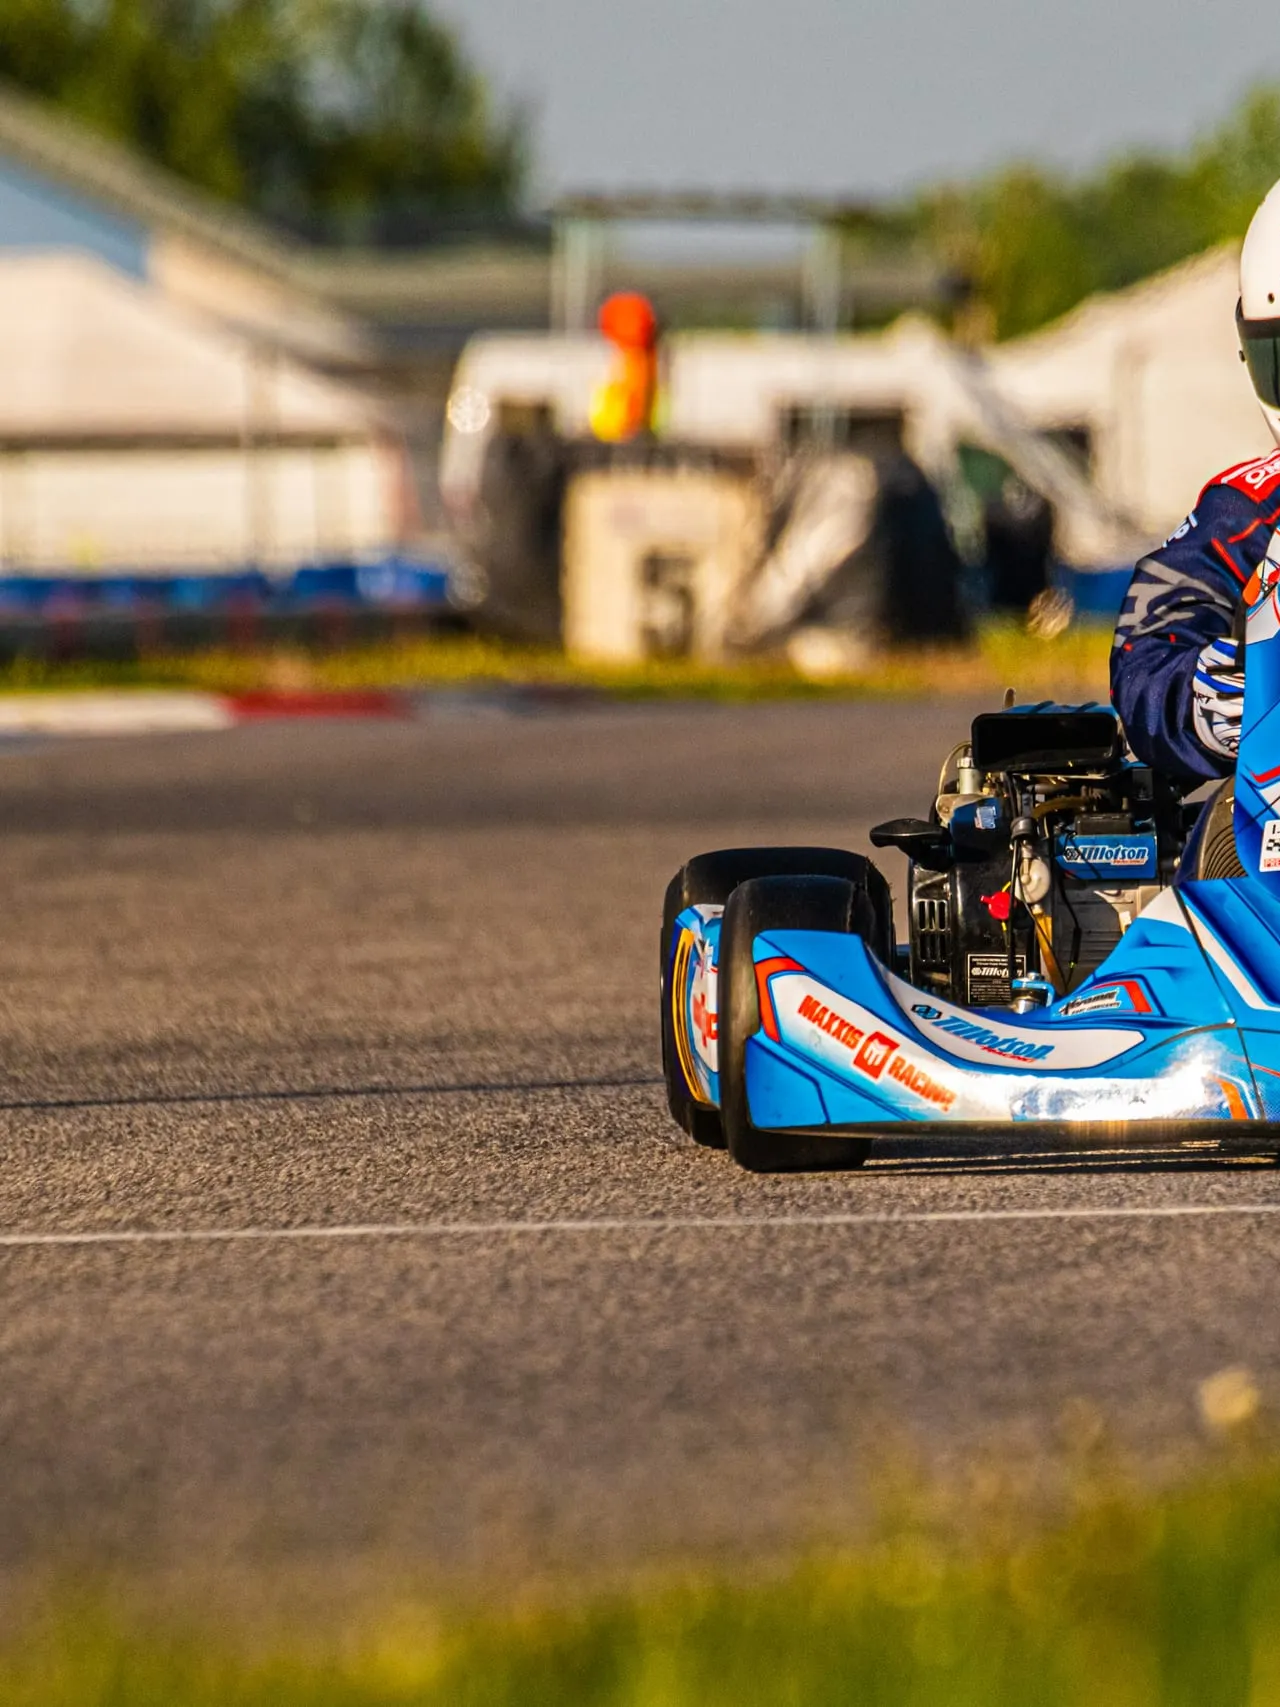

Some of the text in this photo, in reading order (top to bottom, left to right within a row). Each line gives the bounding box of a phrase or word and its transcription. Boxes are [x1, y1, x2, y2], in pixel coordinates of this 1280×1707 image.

[1080, 845, 1148, 861] Tillotson
[798, 994, 865, 1051] MAXXIS
[888, 1056, 957, 1113] RACING
[931, 1015, 1056, 1060] Tillotson
